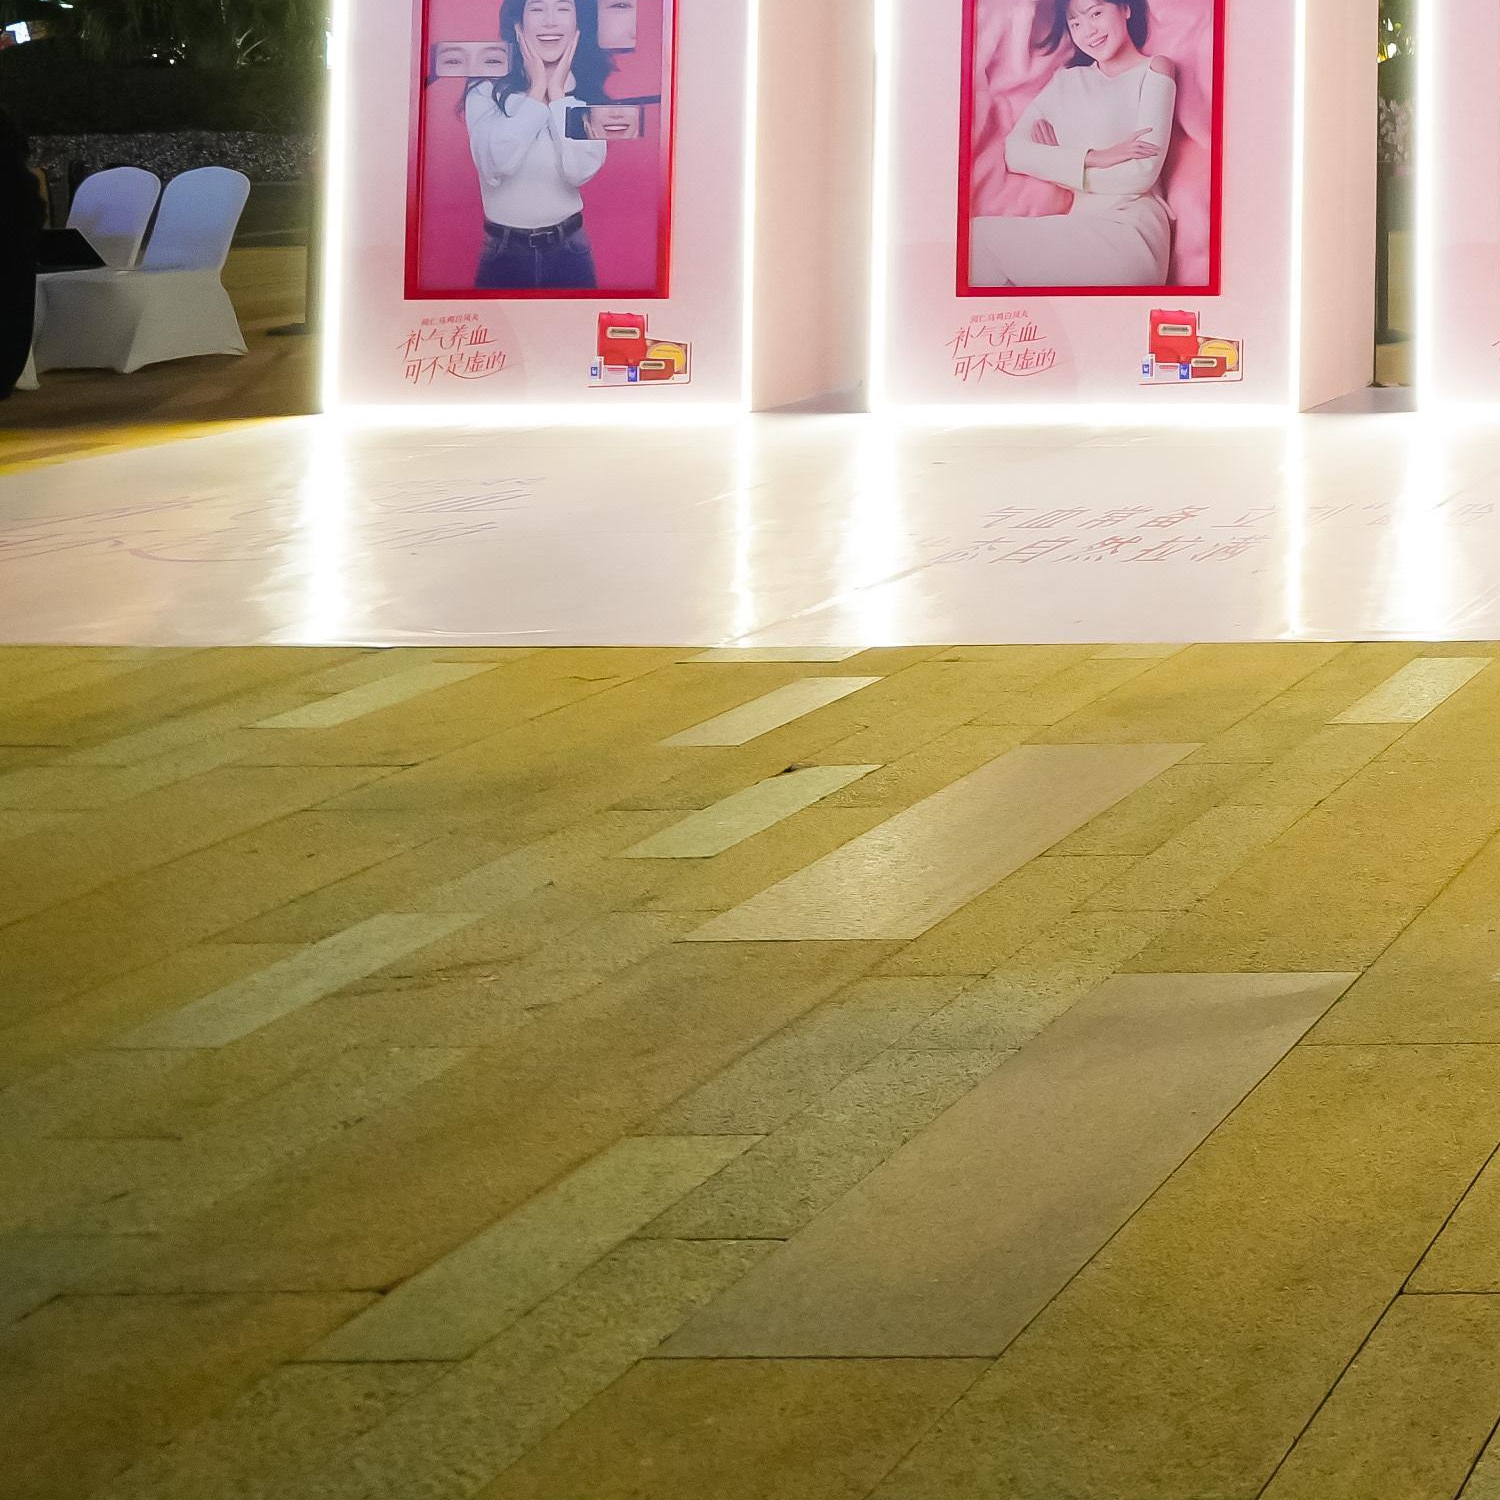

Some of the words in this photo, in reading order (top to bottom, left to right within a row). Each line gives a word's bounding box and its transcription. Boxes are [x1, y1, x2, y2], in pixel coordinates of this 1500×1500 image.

[396, 324, 497, 360] 补气养血
[946, 321, 1047, 358] 补气养血
[405, 349, 508, 387] 可不是虚的
[952, 347, 1057, 382] 可不是虚的
